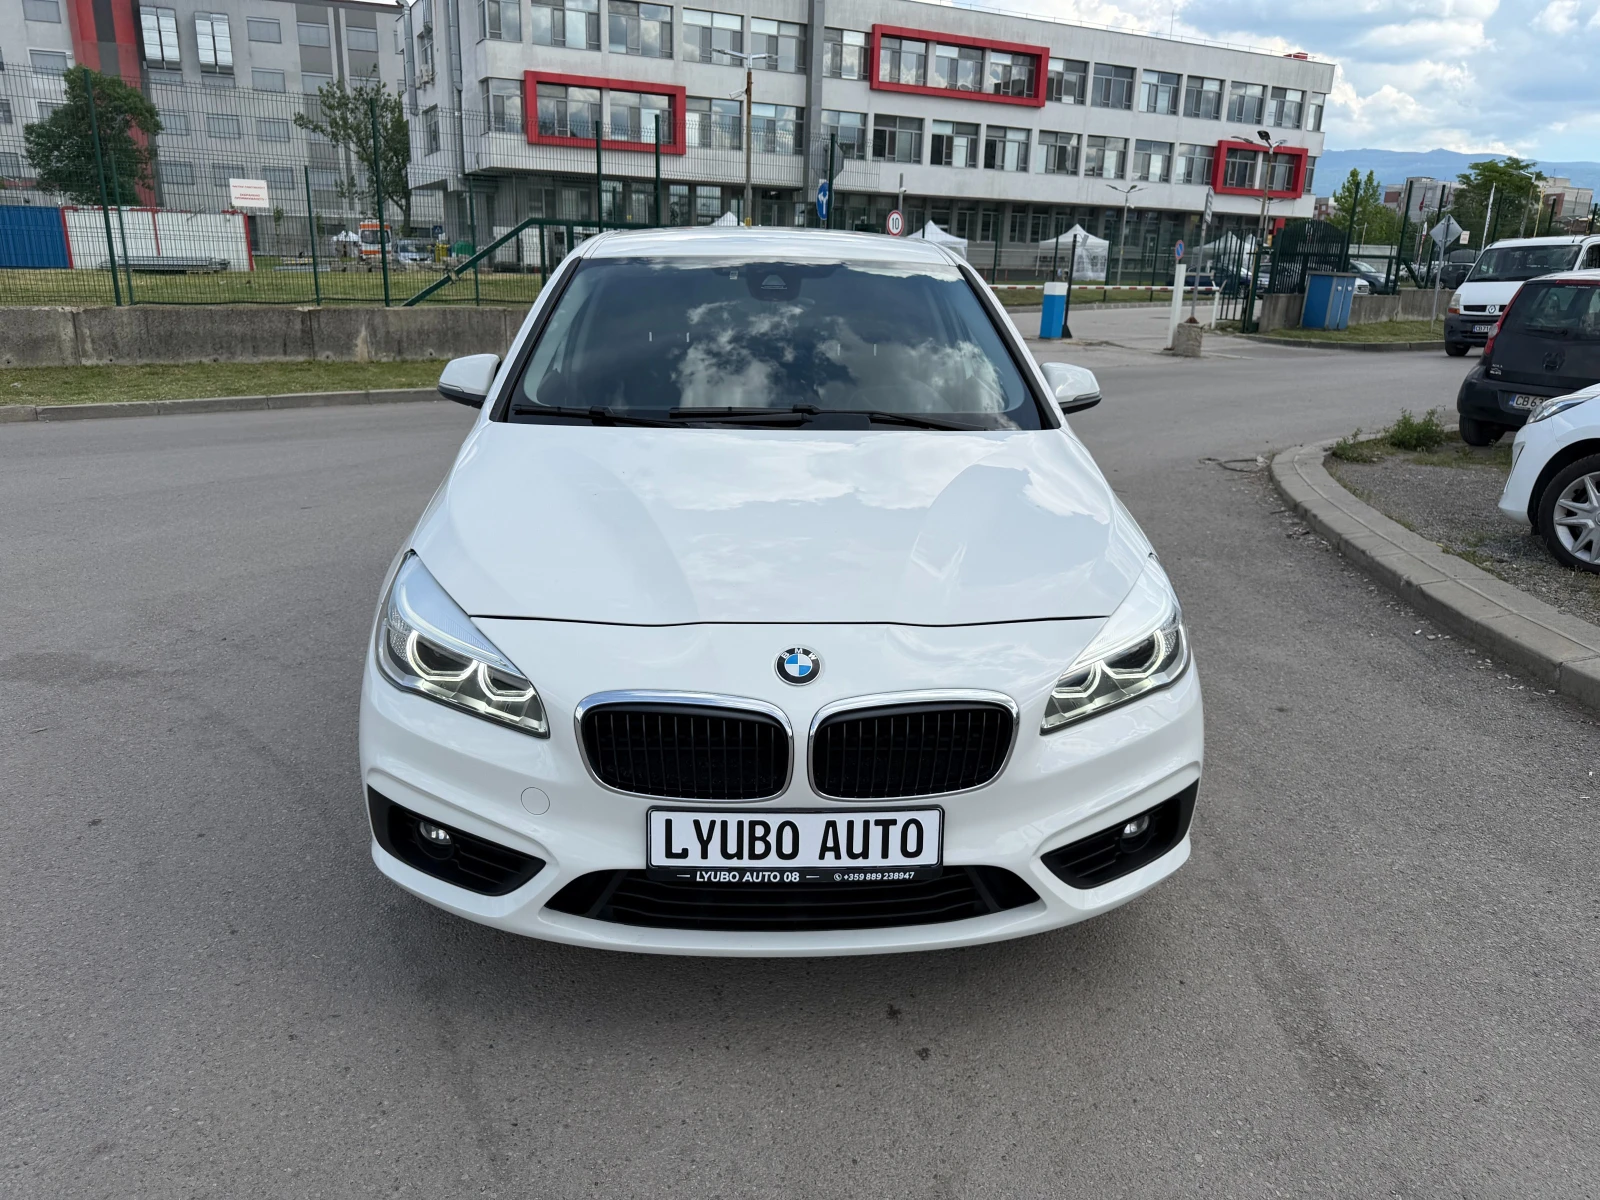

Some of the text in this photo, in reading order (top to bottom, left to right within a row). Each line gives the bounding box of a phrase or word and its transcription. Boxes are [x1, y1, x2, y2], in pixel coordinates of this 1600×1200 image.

[891, 217, 900, 230] 10
[1516, 395, 1530, 407] CB
[780, 647, 818, 660] BMW
[664, 817, 925, 861] LYUBO AUTO
[696, 871, 800, 883] LYUBO AUTO 08
[843, 871, 915, 881] +359 889 238947
